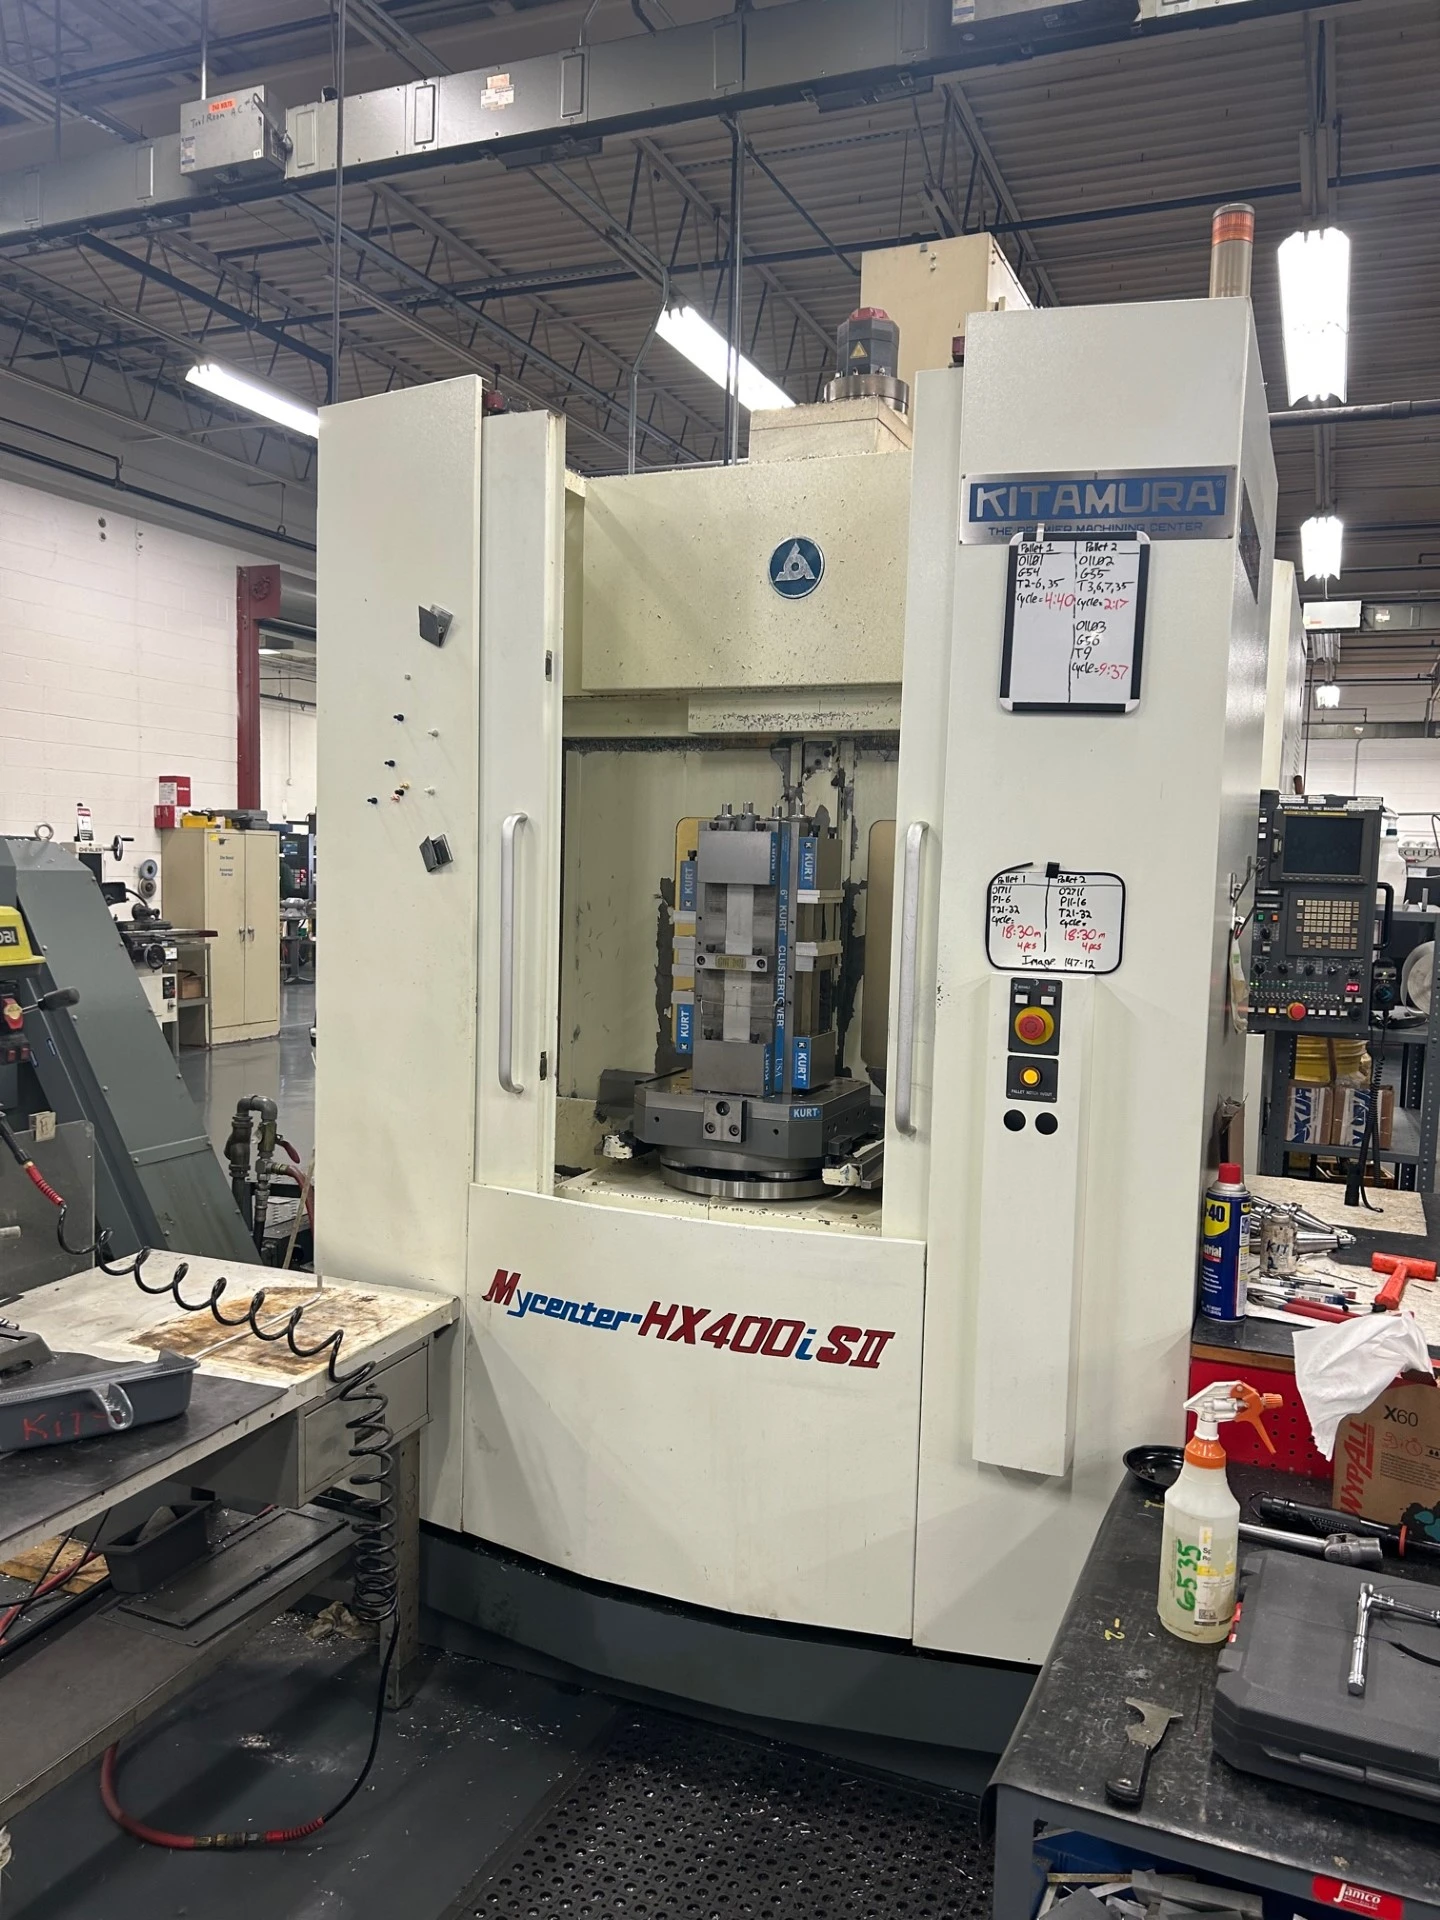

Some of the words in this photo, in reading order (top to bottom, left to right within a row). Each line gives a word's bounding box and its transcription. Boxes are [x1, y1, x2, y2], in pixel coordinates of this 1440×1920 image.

[976, 481, 1217, 518] KITAMURA
[988, 526, 1012, 536] THE
[1150, 521, 1203, 532] CENTER
[1110, 542, 1118, 552] 2
[803, 852, 813, 881] KURT
[684, 867, 694, 894] KURT
[778, 905, 788, 931] KURT
[680, 1011, 690, 1038] KURT
[775, 1058, 783, 1078] USA
[797, 1052, 807, 1081] KURT
[793, 1107, 818, 1118] KURT
[1384, 1405, 1418, 1427] X60
[1176, 1538, 1201, 1612] 6535
[1333, 1883, 1381, 1904] Jamco
